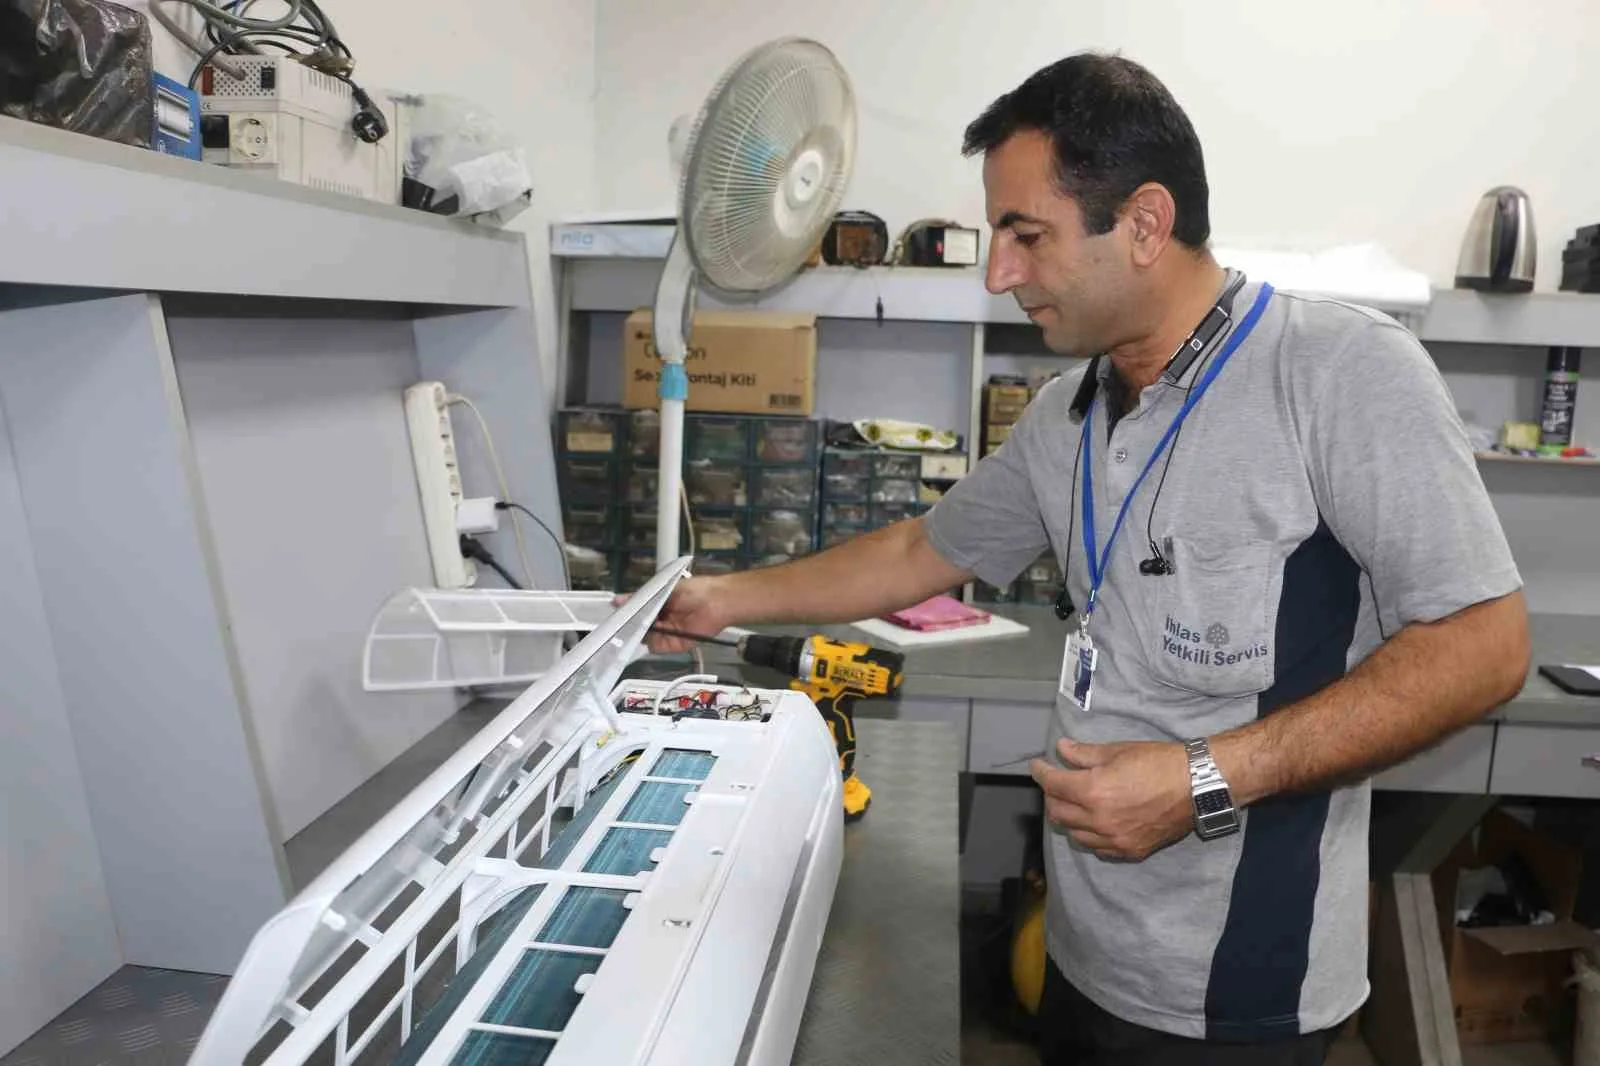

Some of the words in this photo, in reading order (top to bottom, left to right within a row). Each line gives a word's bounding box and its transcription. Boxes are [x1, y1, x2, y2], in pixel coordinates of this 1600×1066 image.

[687, 371, 727, 388] ontaj
[730, 373, 757, 387] Kiti
[1163, 634, 1210, 665] Yetkili
[1213, 643, 1268, 666] Servis
